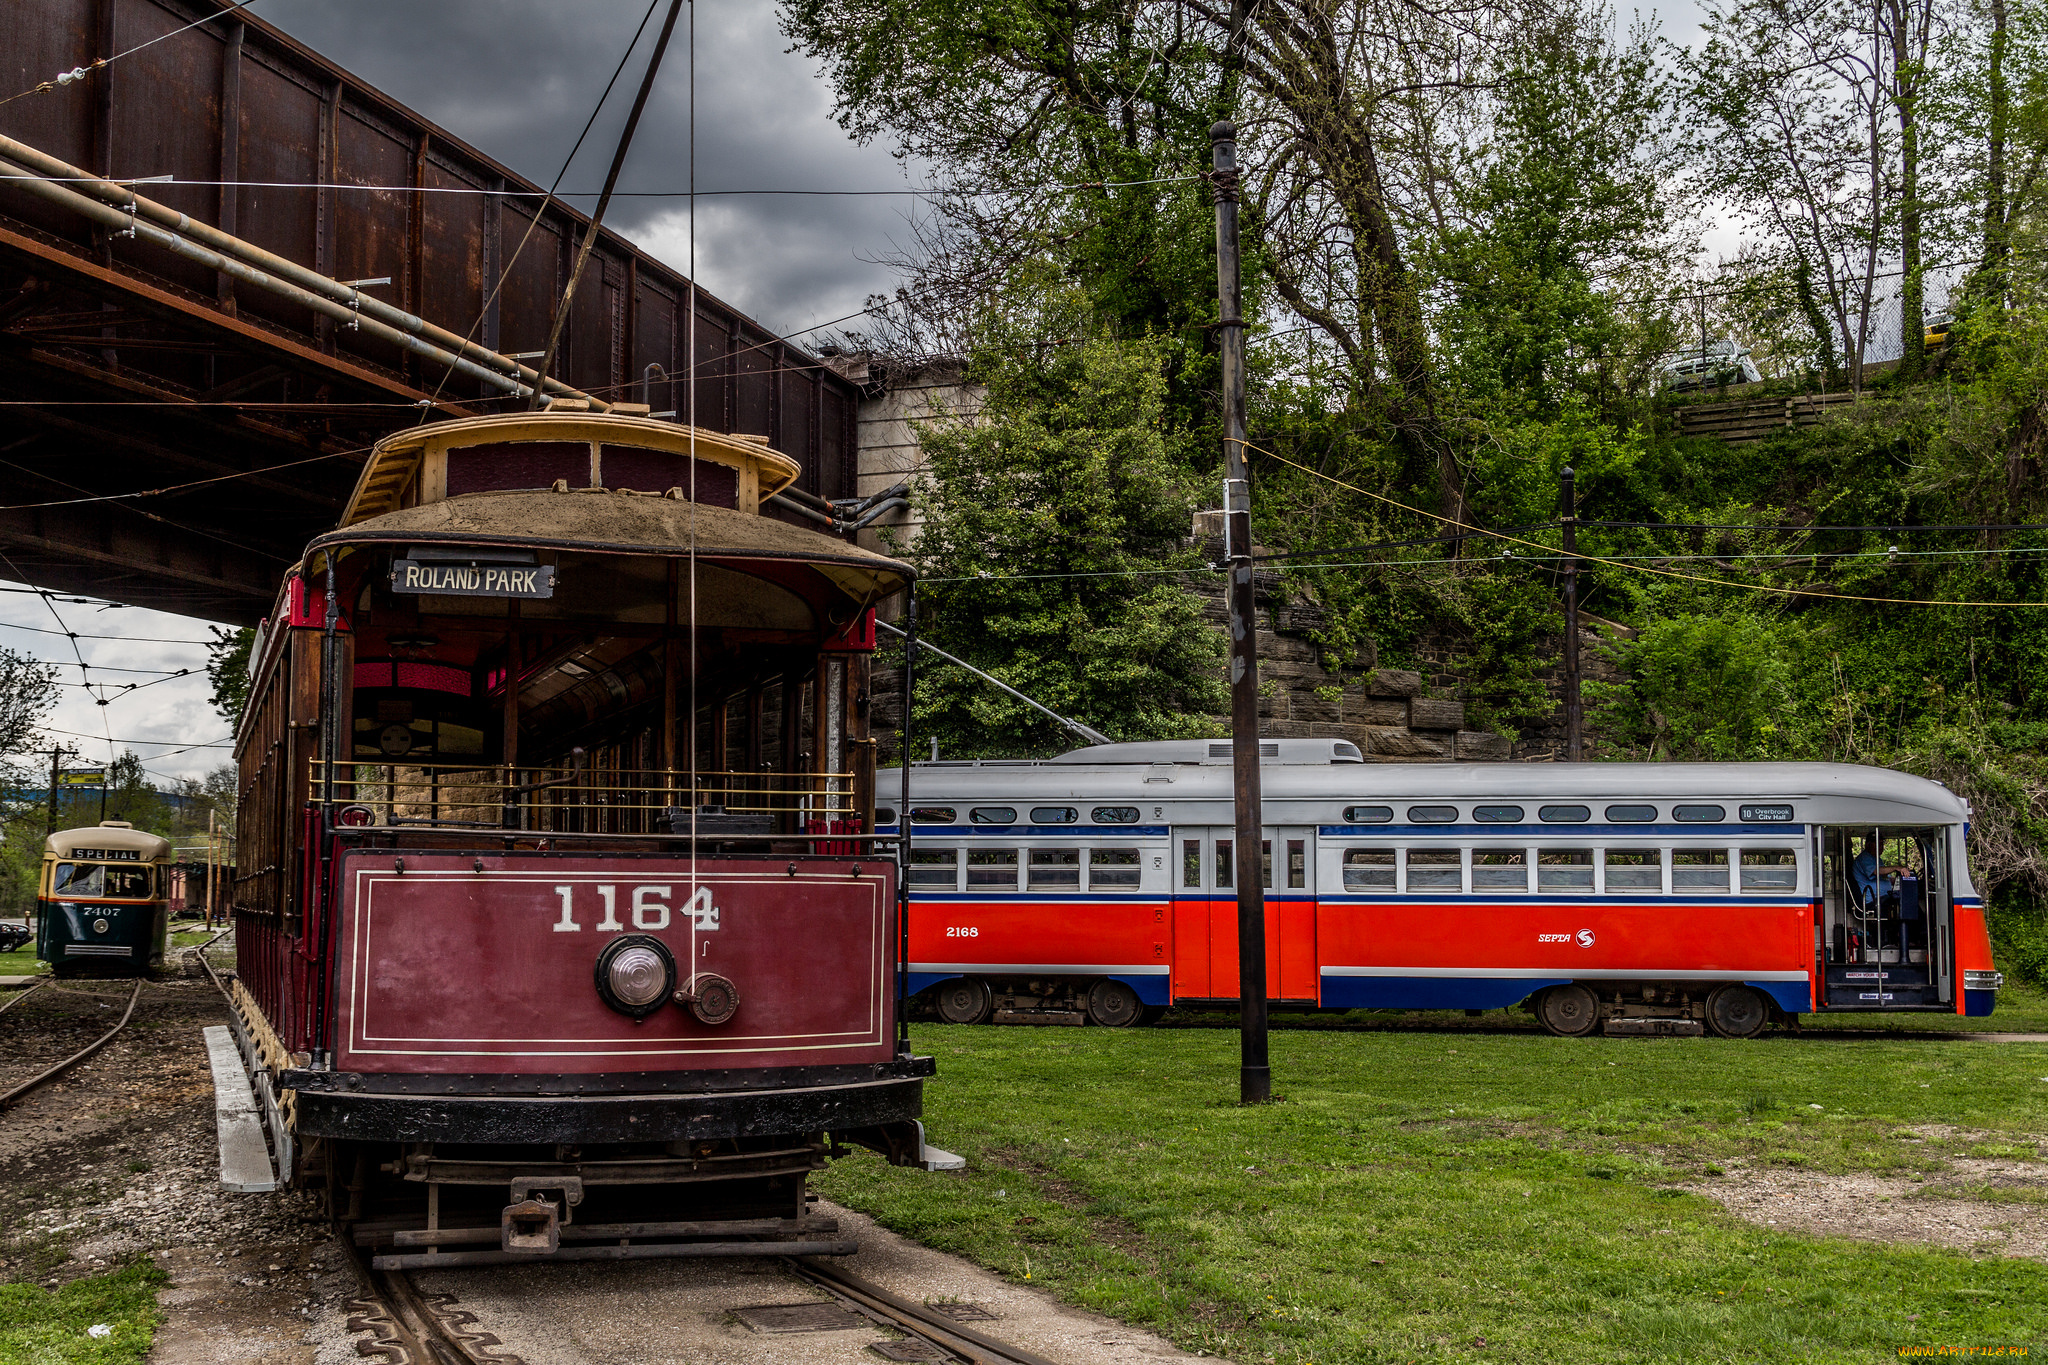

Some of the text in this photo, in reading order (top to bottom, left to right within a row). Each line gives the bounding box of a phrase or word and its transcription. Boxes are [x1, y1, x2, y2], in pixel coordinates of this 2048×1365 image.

[406, 566, 538, 593] ROLAND PARK
[1743, 809, 1752, 818] 10
[76, 849, 136, 860] SPECIAL
[83, 907, 121, 917] 7407
[553, 885, 721, 932] 1164
[946, 926, 979, 937] 2168
[1538, 934, 1571, 942] SEPTA
